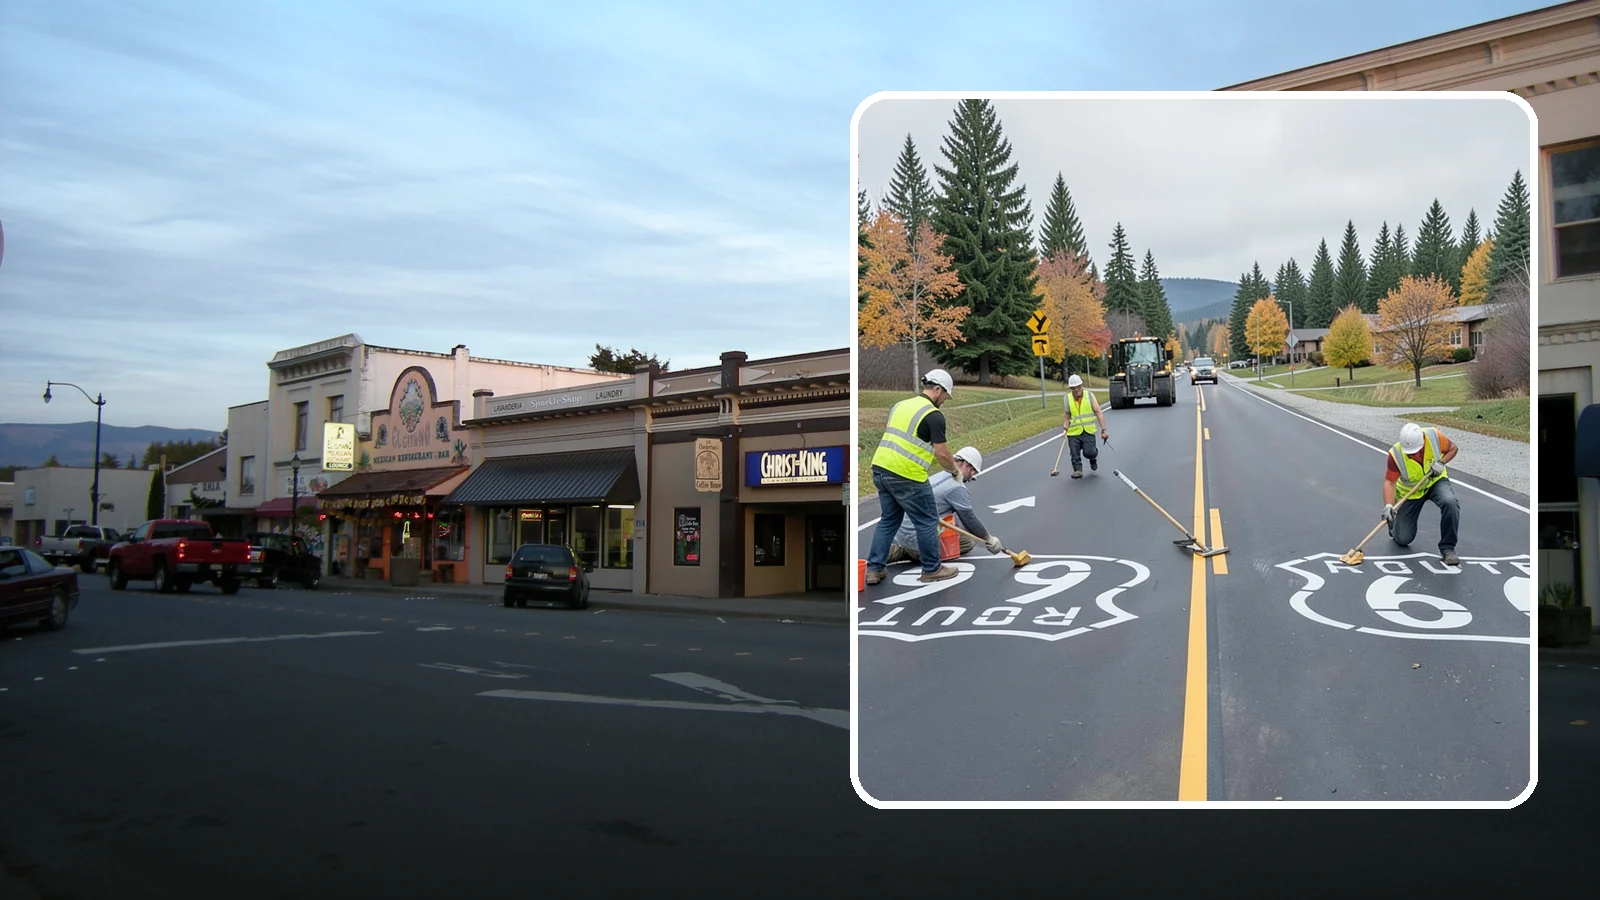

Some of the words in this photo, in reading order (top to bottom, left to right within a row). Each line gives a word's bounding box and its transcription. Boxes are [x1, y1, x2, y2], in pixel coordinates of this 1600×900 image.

[595, 389, 624, 400] LAUNDRY
[493, 402, 523, 413] LAVANDERIA
[531, 398, 560, 409] Sparkle
[561, 395, 582, 405] Shop
[373, 454, 396, 464] MEXICAN
[397, 451, 433, 462] RESTAURANT
[438, 450, 450, 459] BAR
[761, 452, 797, 478] CHRIST
[799, 450, 827, 476] KING
